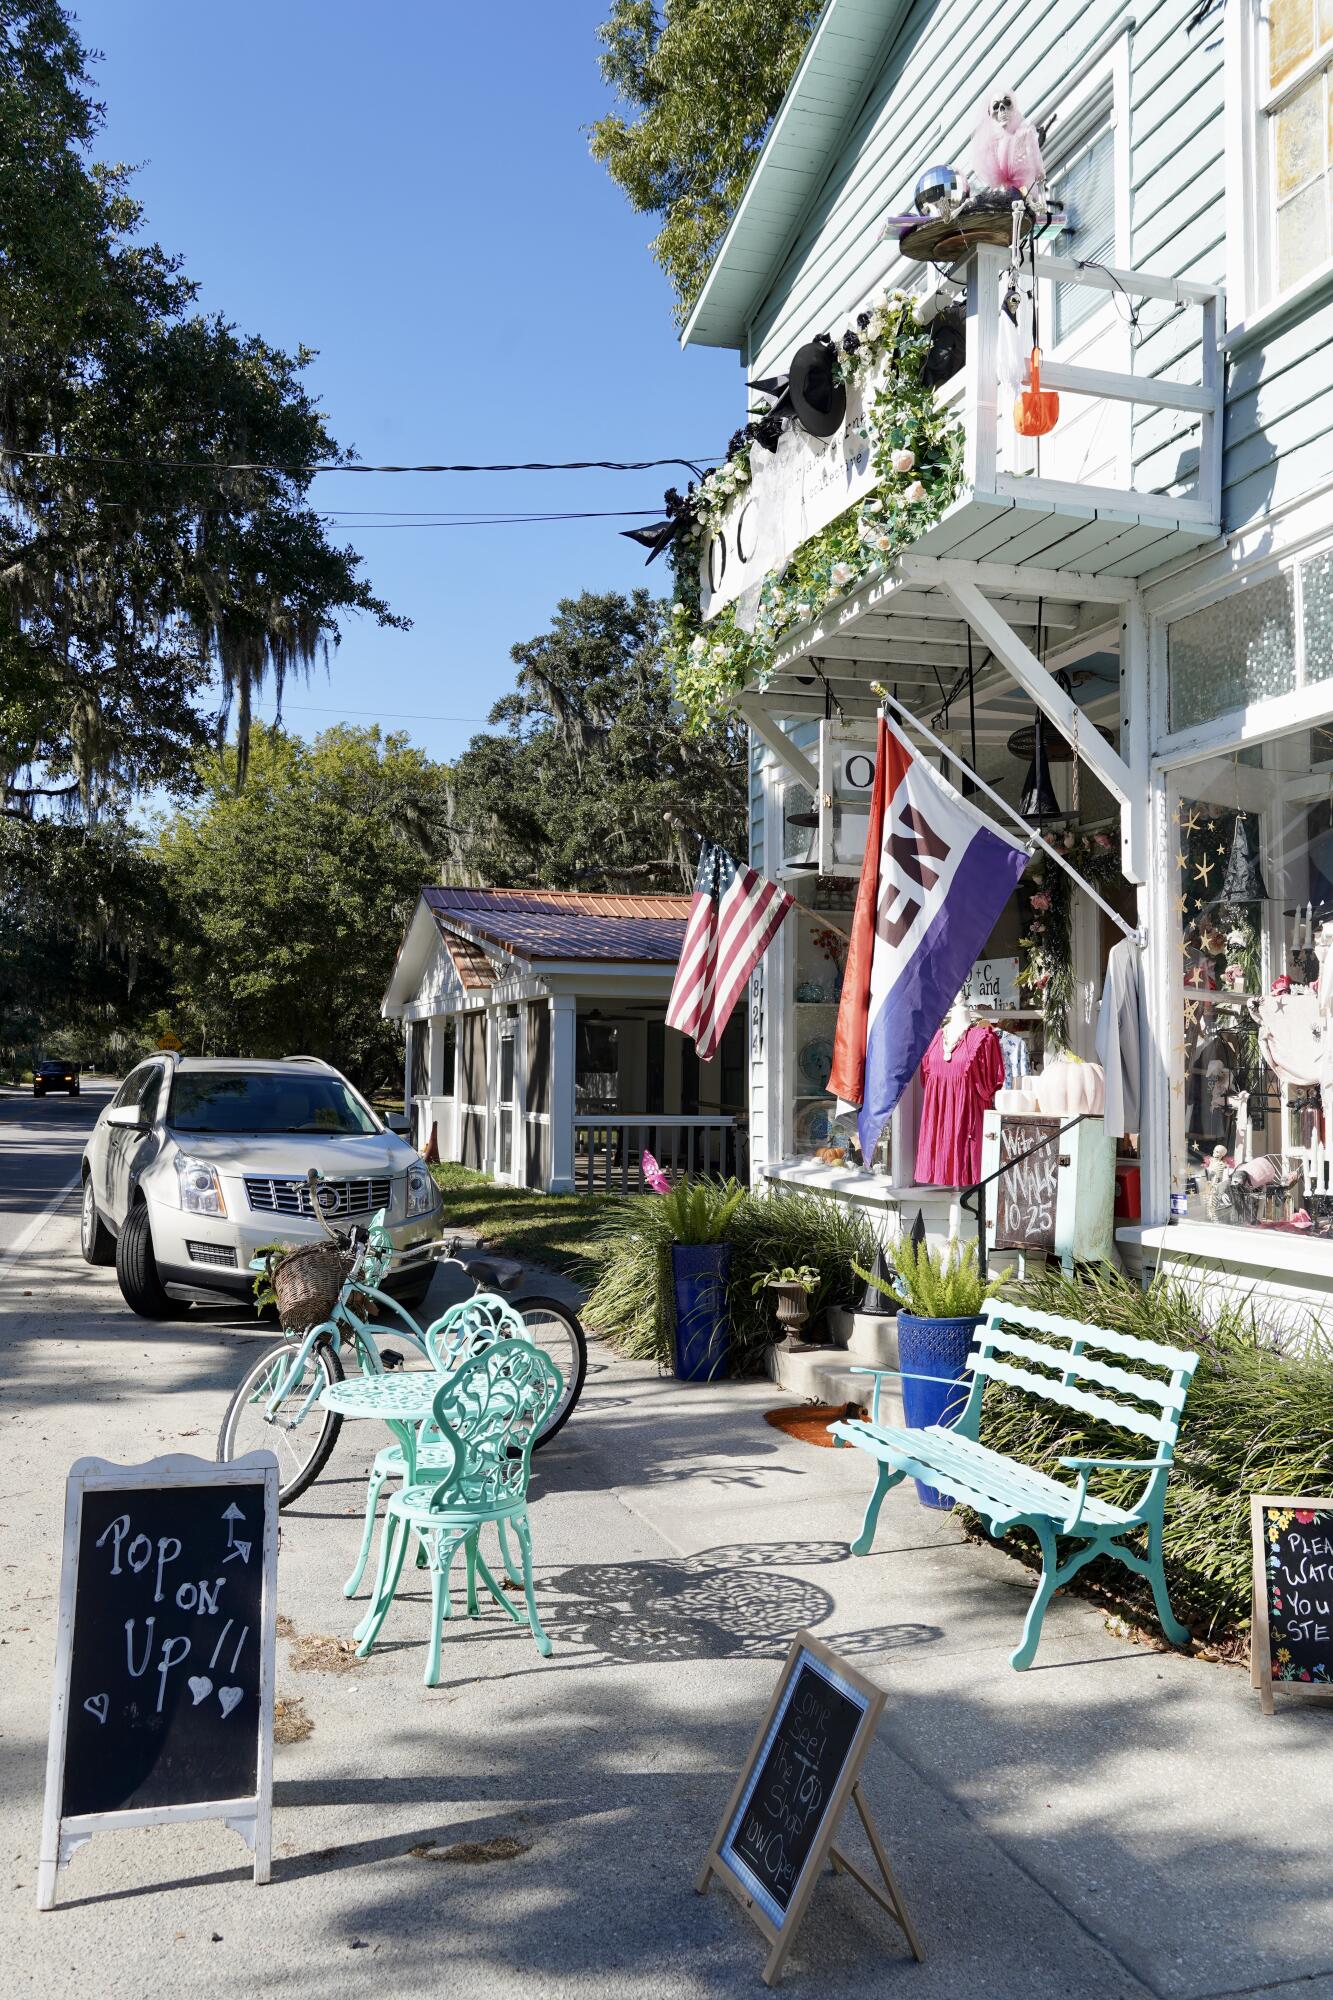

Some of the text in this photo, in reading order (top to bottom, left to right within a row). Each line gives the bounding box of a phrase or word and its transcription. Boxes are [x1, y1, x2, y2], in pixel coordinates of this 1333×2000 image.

[845, 754, 875, 788] O
[979, 977, 1001, 996] and
[983, 964, 993, 982] C
[752, 979, 760, 1054] 824
[1004, 1200, 1053, 1239] 10-25
[1287, 1620, 1330, 1641] STE
[763, 1784, 803, 1844] Shop
